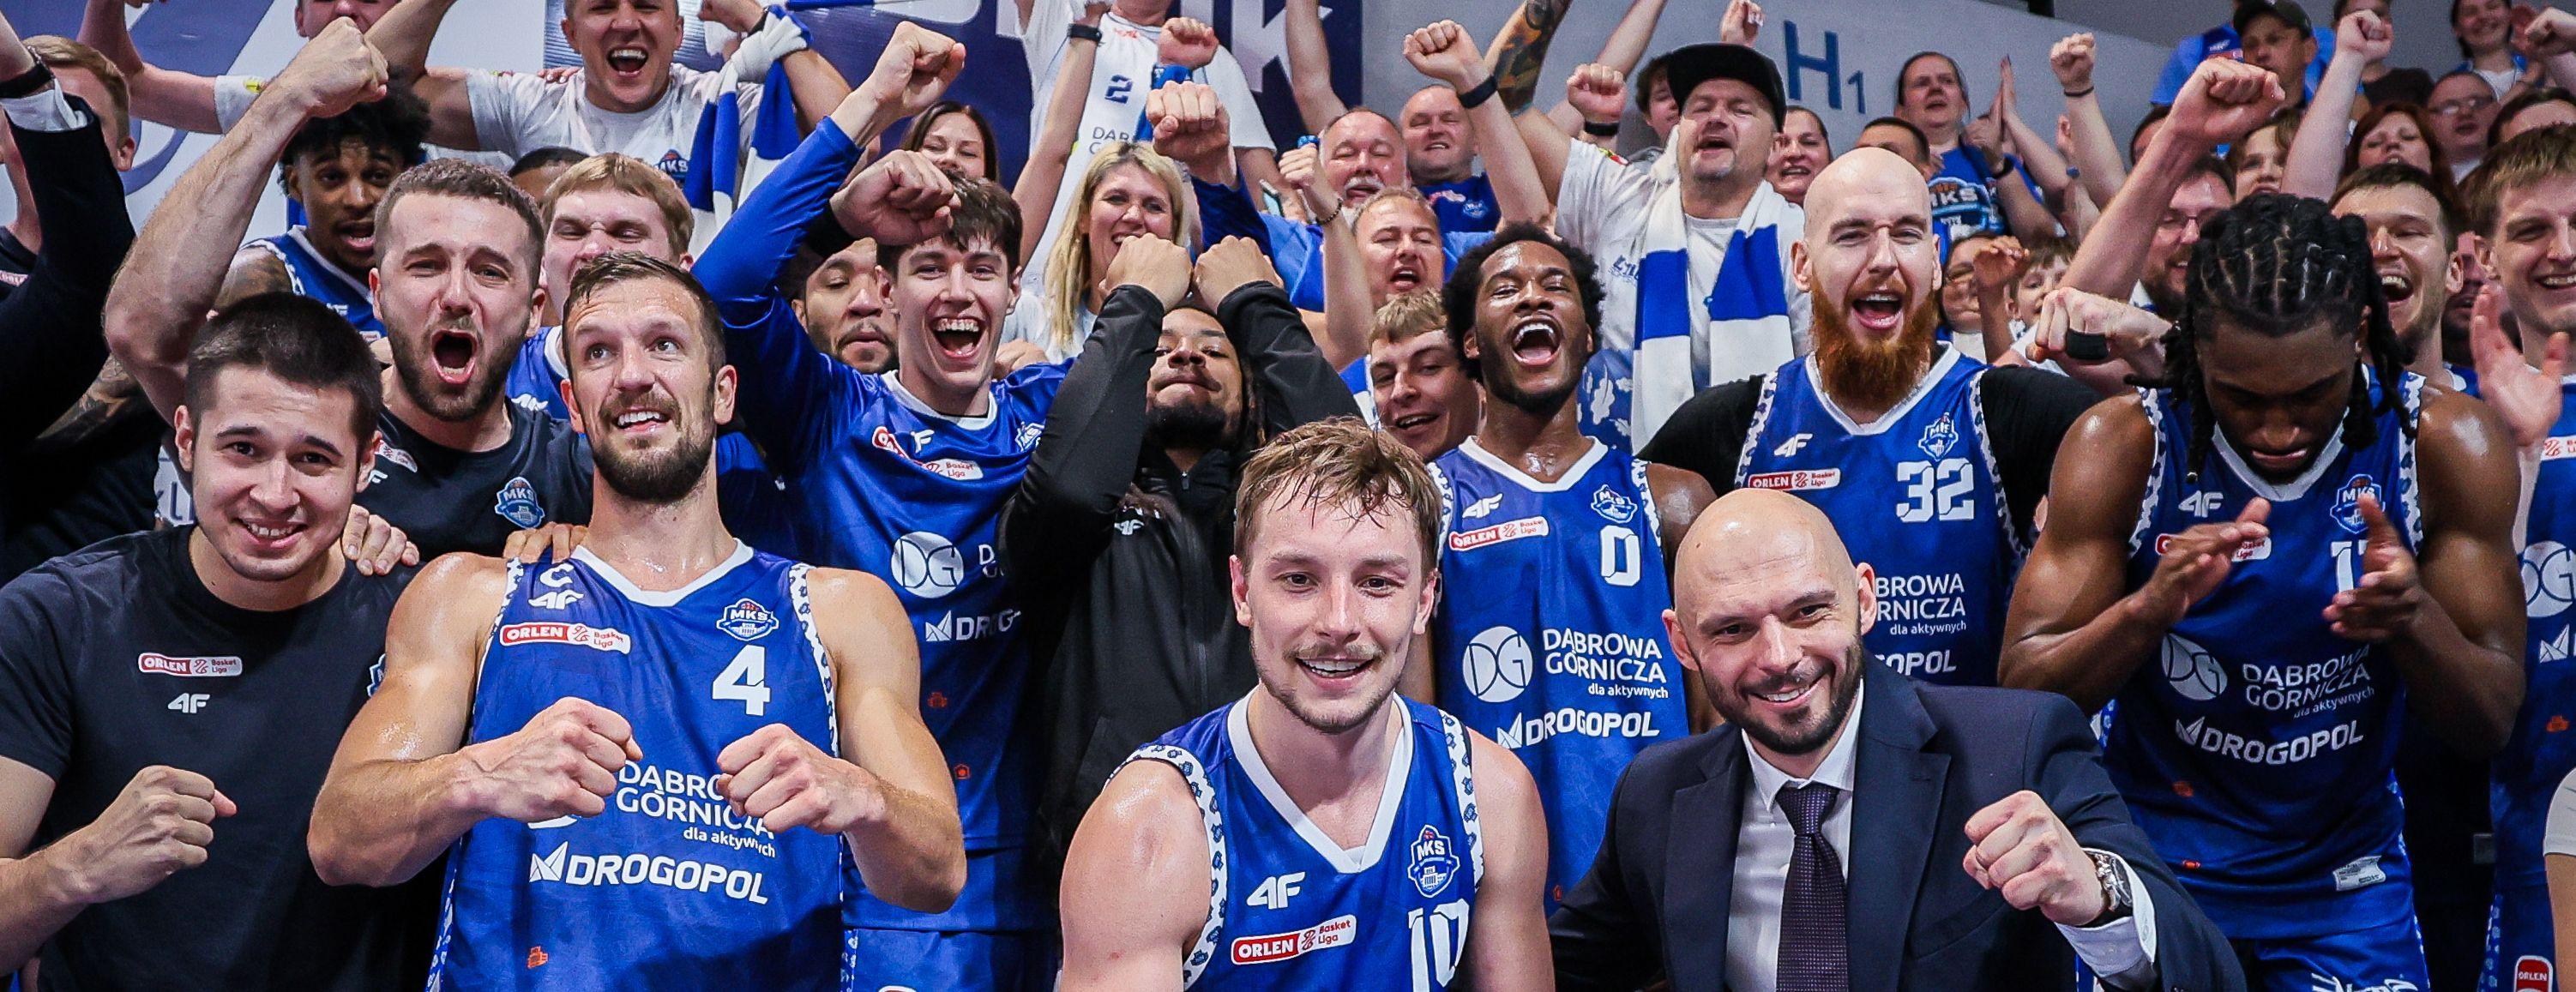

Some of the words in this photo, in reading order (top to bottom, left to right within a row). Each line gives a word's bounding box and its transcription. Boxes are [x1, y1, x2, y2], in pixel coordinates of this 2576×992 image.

[1104, 74, 1134, 105] 2
[1773, 433, 1814, 458] 4F
[1752, 476, 1790, 489] ORLEN
[1896, 457, 1975, 523] 32
[503, 487, 535, 502] MKS
[2178, 490, 2224, 518] 4F
[1454, 530, 1499, 548] ORLEN
[1600, 525, 1641, 587] 0
[539, 562, 575, 588] C
[1875, 572, 1965, 598] BROWA
[527, 589, 585, 610] 4F
[1876, 596, 1966, 622] RNICZA
[730, 608, 769, 622] MKS
[506, 626, 564, 641] ORLEN
[1890, 623, 1908, 635] dla
[1911, 620, 1967, 636] aktywnych
[593, 638, 614, 649] Liga
[143, 657, 188, 672] ORLEN
[1545, 650, 1667, 684] GÓRNICZA
[1887, 649, 1958, 676] OPOL
[712, 644, 771, 717] 4
[1587, 682, 1605, 696] dla
[1607, 684, 1669, 700] aktywnych
[167, 692, 211, 714] 4F
[2312, 685, 2375, 713] aktywnych
[1526, 707, 1661, 747] DROGOPOL
[2200, 719, 2364, 766] DROGOPOL
[683, 827, 707, 842] dla
[1417, 839, 1446, 861] MKS
[565, 853, 768, 905] DROGOPOL
[1246, 871, 1306, 910] 4F
[1319, 919, 1352, 934] Basket
[1237, 938, 1295, 959] ORLEN
[1317, 934, 1339, 947] Liga
[1408, 898, 1470, 992] 10
[2518, 971, 2548, 982] ORLEN
